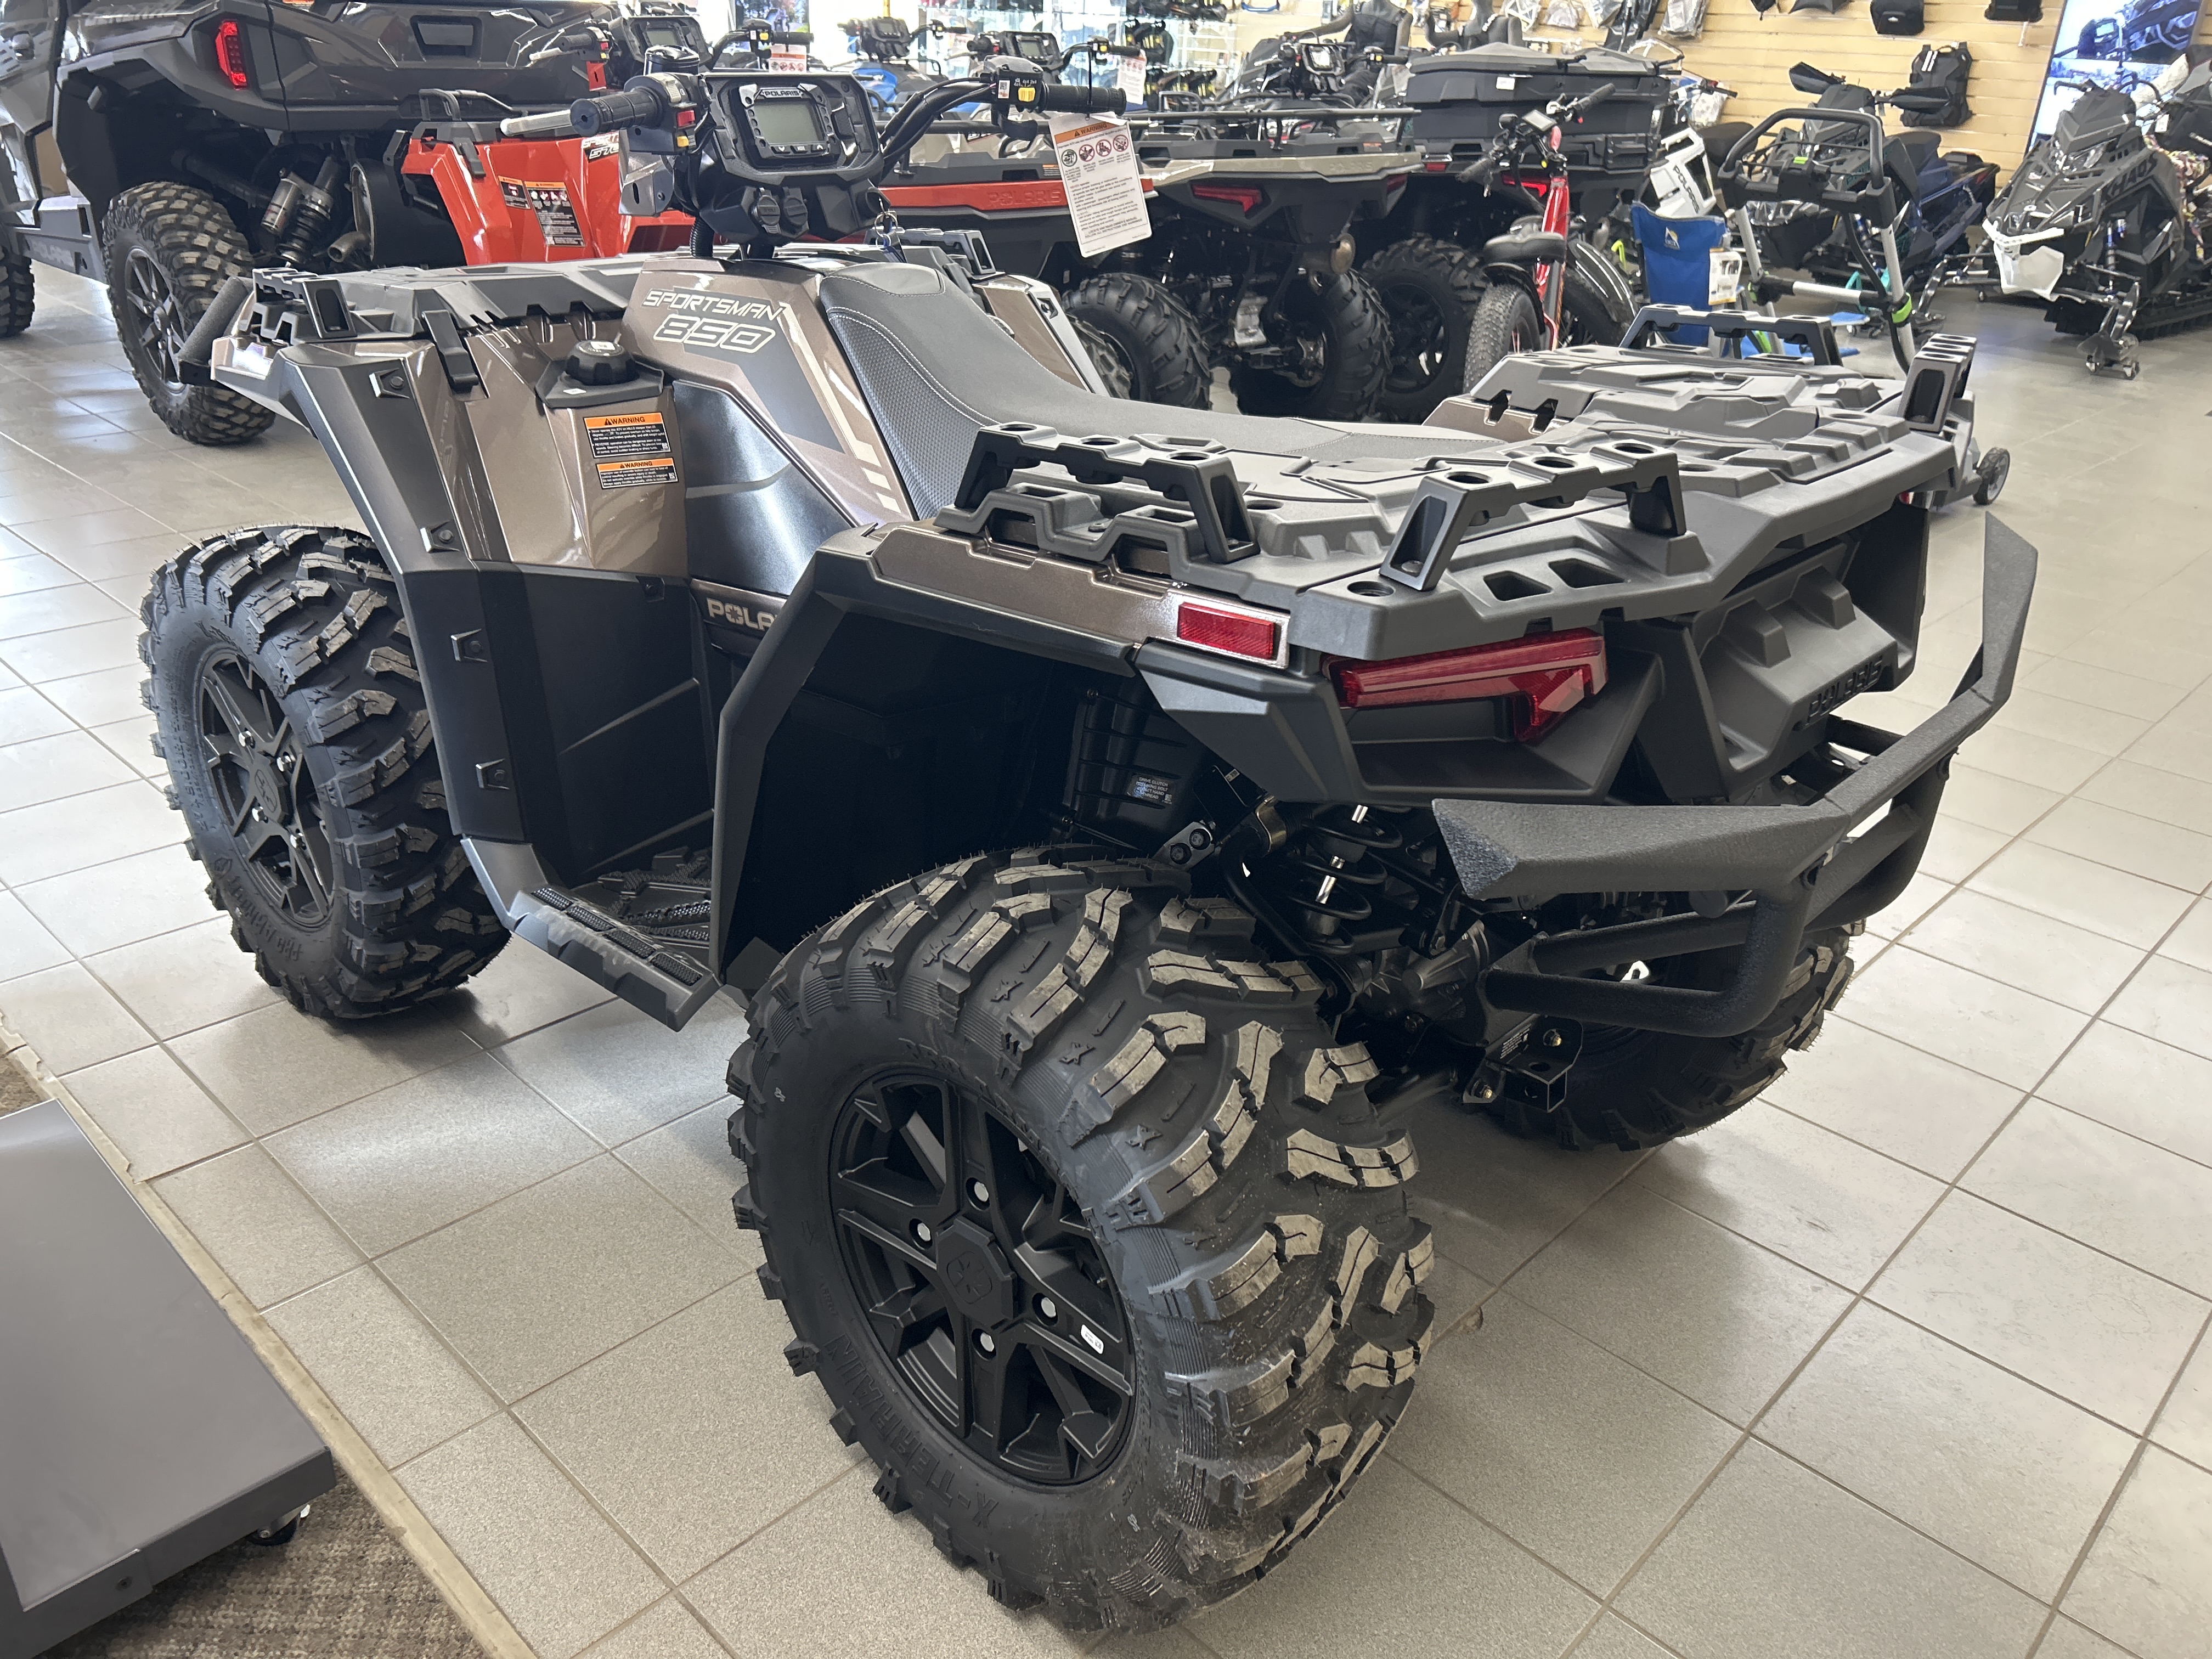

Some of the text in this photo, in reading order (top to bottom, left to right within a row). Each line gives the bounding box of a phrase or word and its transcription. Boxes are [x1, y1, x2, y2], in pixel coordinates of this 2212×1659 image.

[583, 132, 619, 148] SPORT
[1080, 123, 1107, 134] WARNING
[988, 189, 1062, 207] POLARIS
[1673, 165, 1700, 214] POLARIS
[644, 291, 783, 320] SPORTSMAN
[653, 314, 776, 353] 850
[611, 416, 645, 425] WARNING
[707, 597, 777, 631] POLA
[1807, 655, 1884, 726] POLARIS
[822, 1331, 1000, 1530] X-TERRAIN
